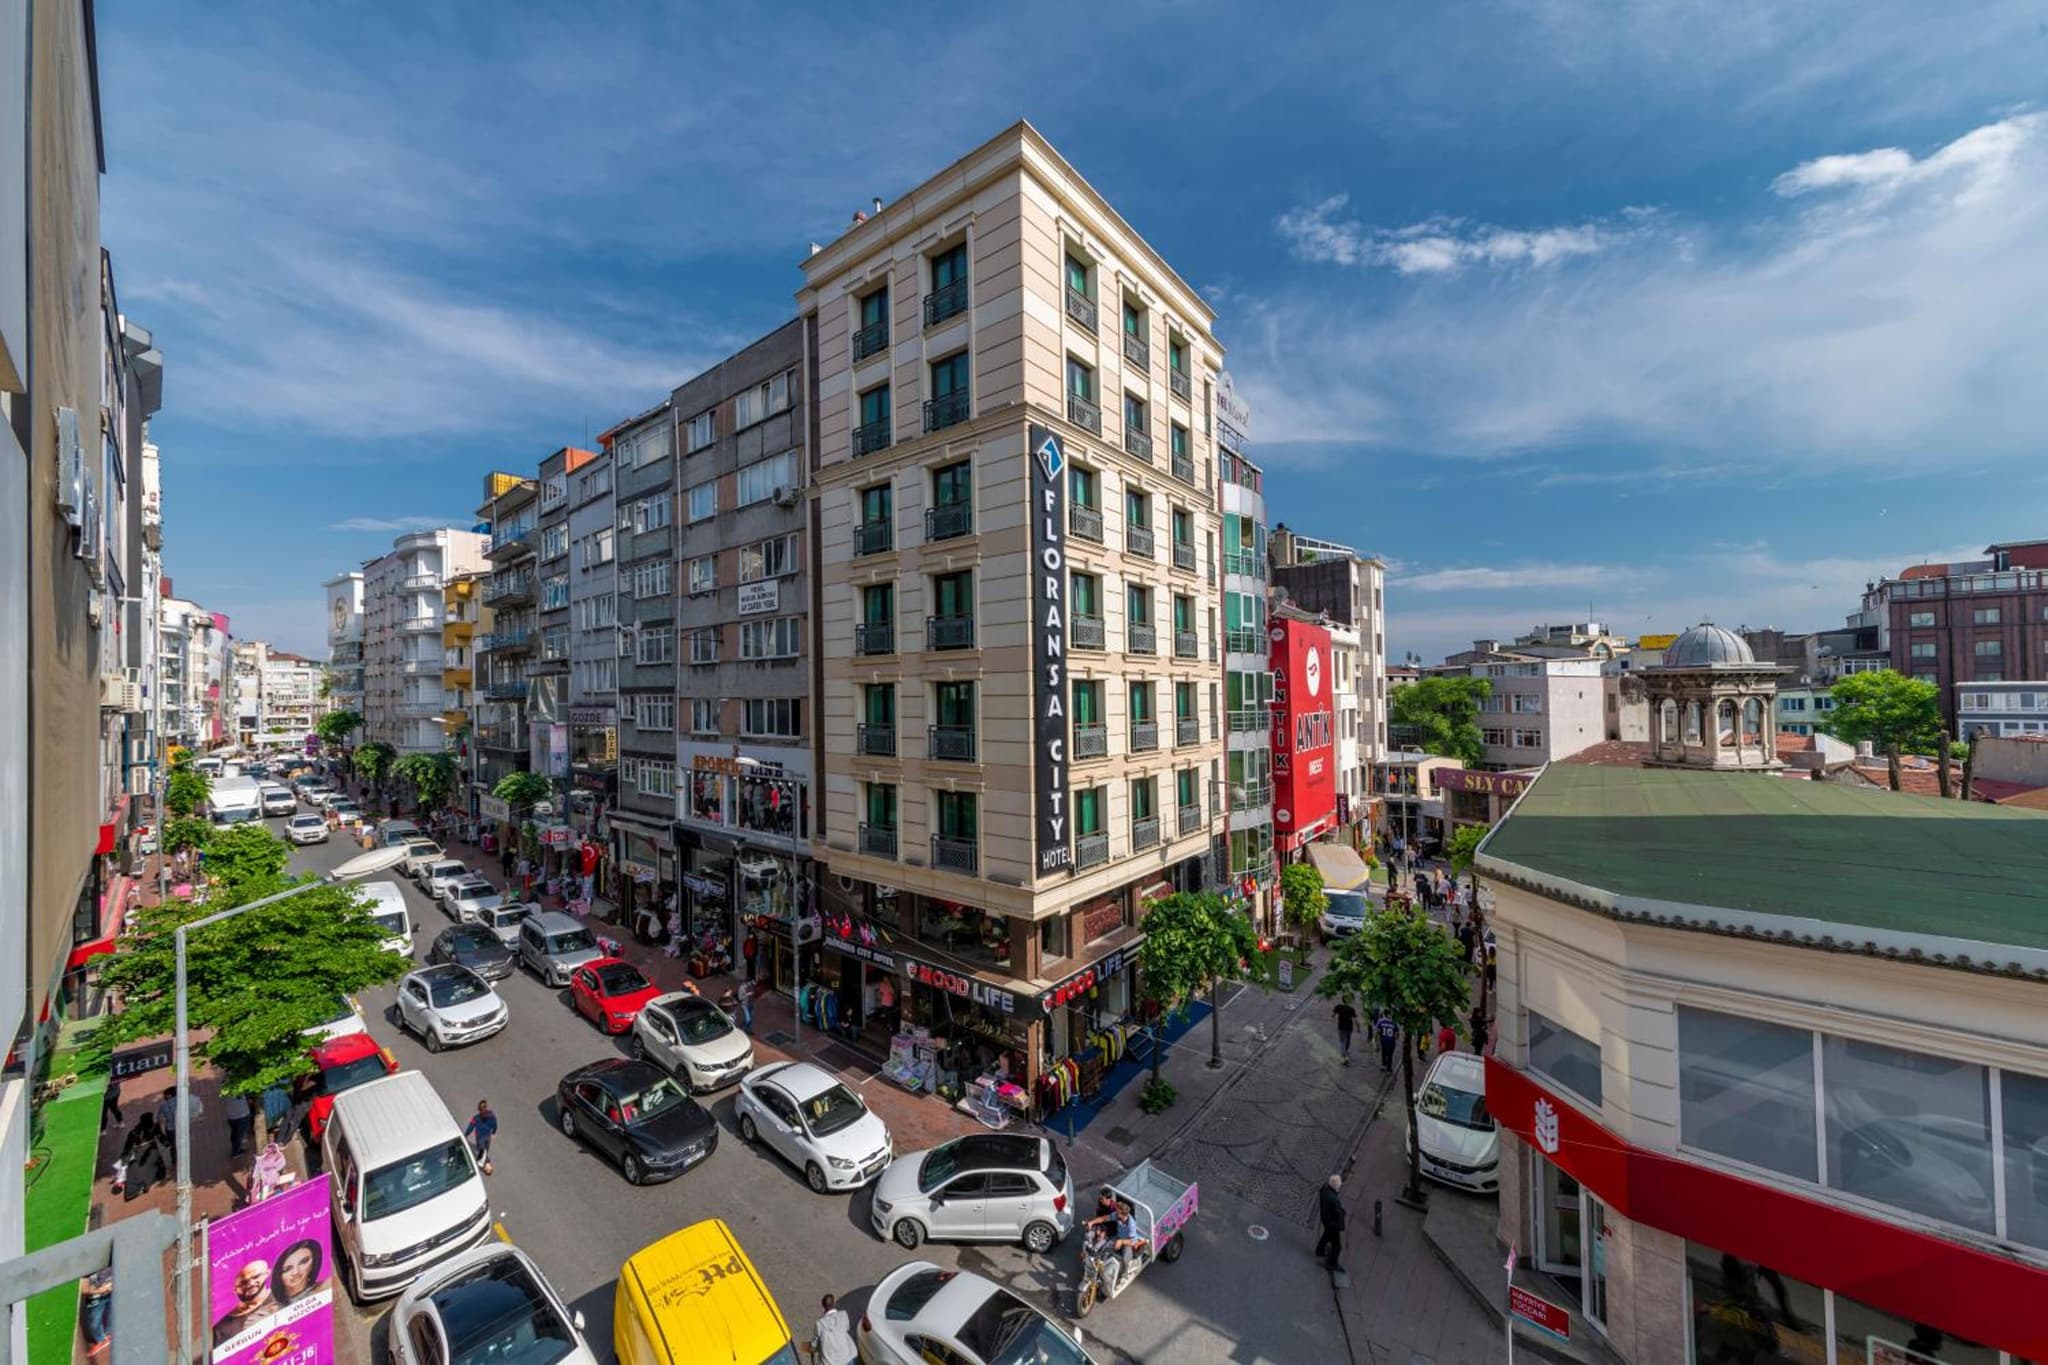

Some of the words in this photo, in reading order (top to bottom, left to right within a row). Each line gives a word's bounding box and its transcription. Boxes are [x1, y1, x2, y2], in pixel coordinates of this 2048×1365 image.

[1044, 489, 1062, 717] FLORANSA
[1049, 739, 1064, 842] CITY
[1464, 774, 1496, 791] SLY
[1501, 779, 1529, 794] CA
[1042, 847, 1071, 870] HOTEL
[1096, 953, 1122, 981] LIFE
[919, 965, 969, 997] MOOD
[973, 982, 1015, 1013] LIFE
